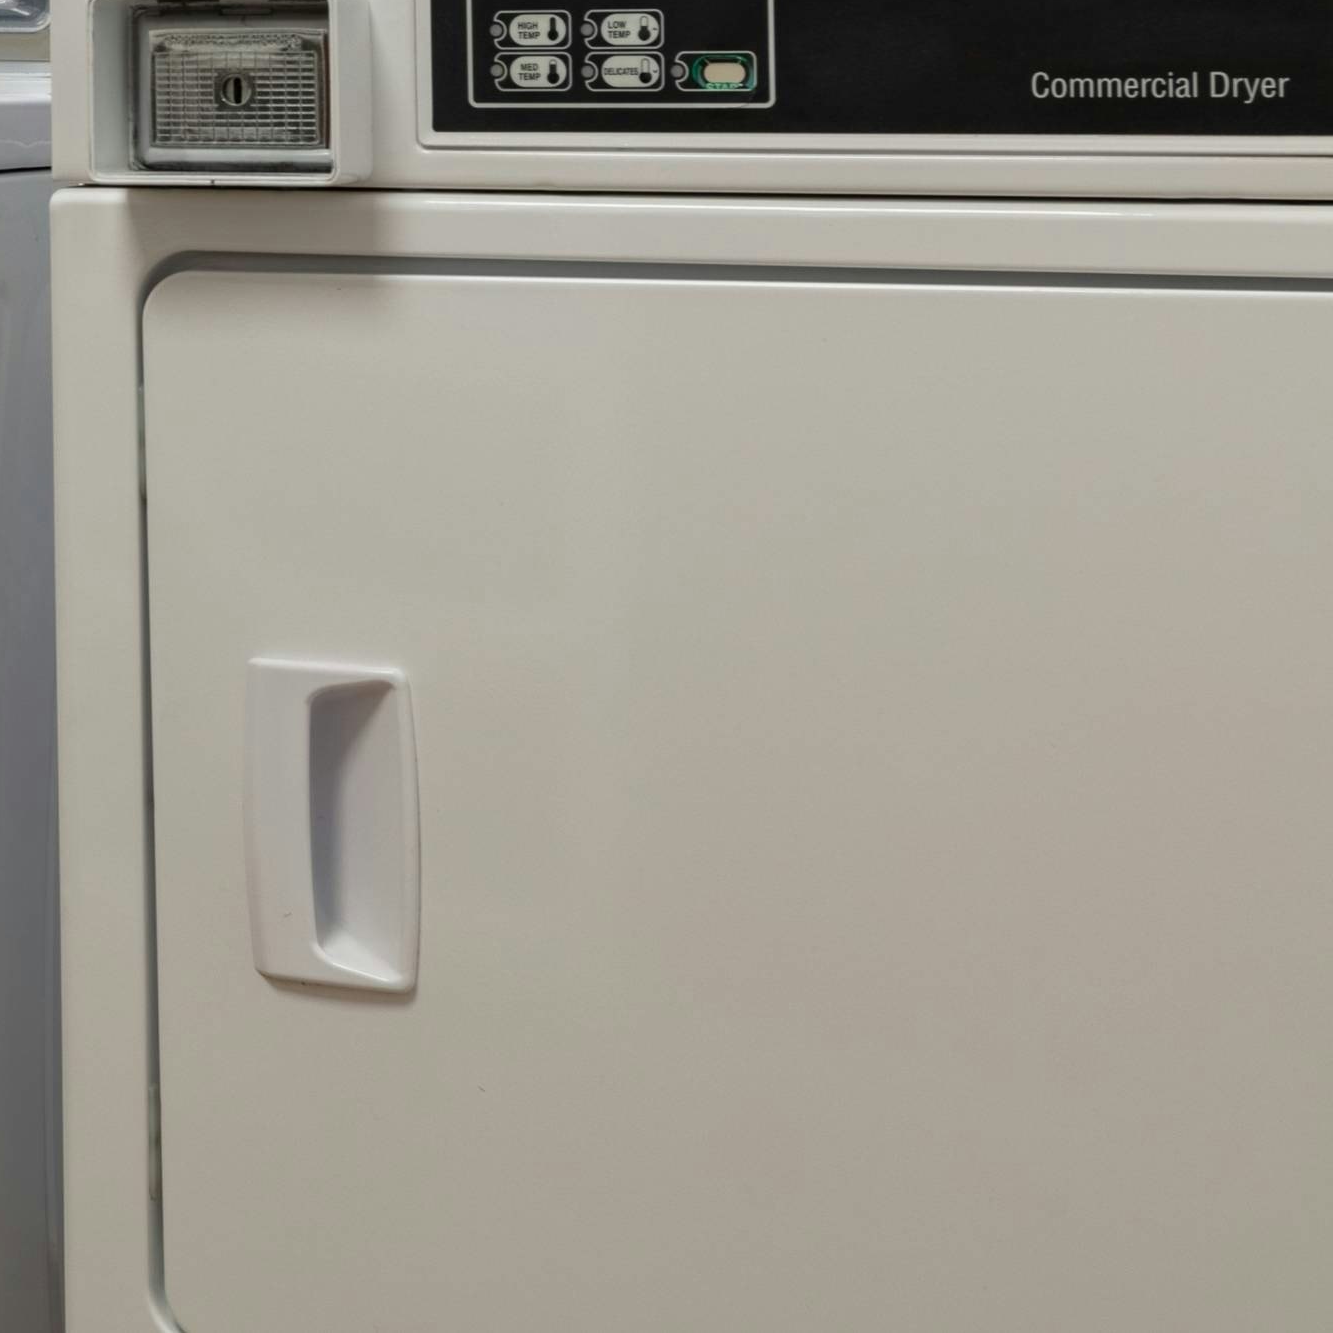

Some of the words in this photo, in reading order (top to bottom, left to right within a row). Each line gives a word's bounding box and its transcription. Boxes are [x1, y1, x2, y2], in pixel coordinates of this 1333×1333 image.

[518, 22, 539, 30] HIGH
[608, 21, 627, 29] LOW
[518, 31, 541, 40] TEMP
[608, 31, 631, 39] TEMP
[520, 63, 539, 71] MED
[604, 67, 639, 76] DELICATES
[518, 73, 541, 81] TEMP
[1030, 70, 1200, 100] Commercial
[1209, 70, 1291, 105] Dryer
